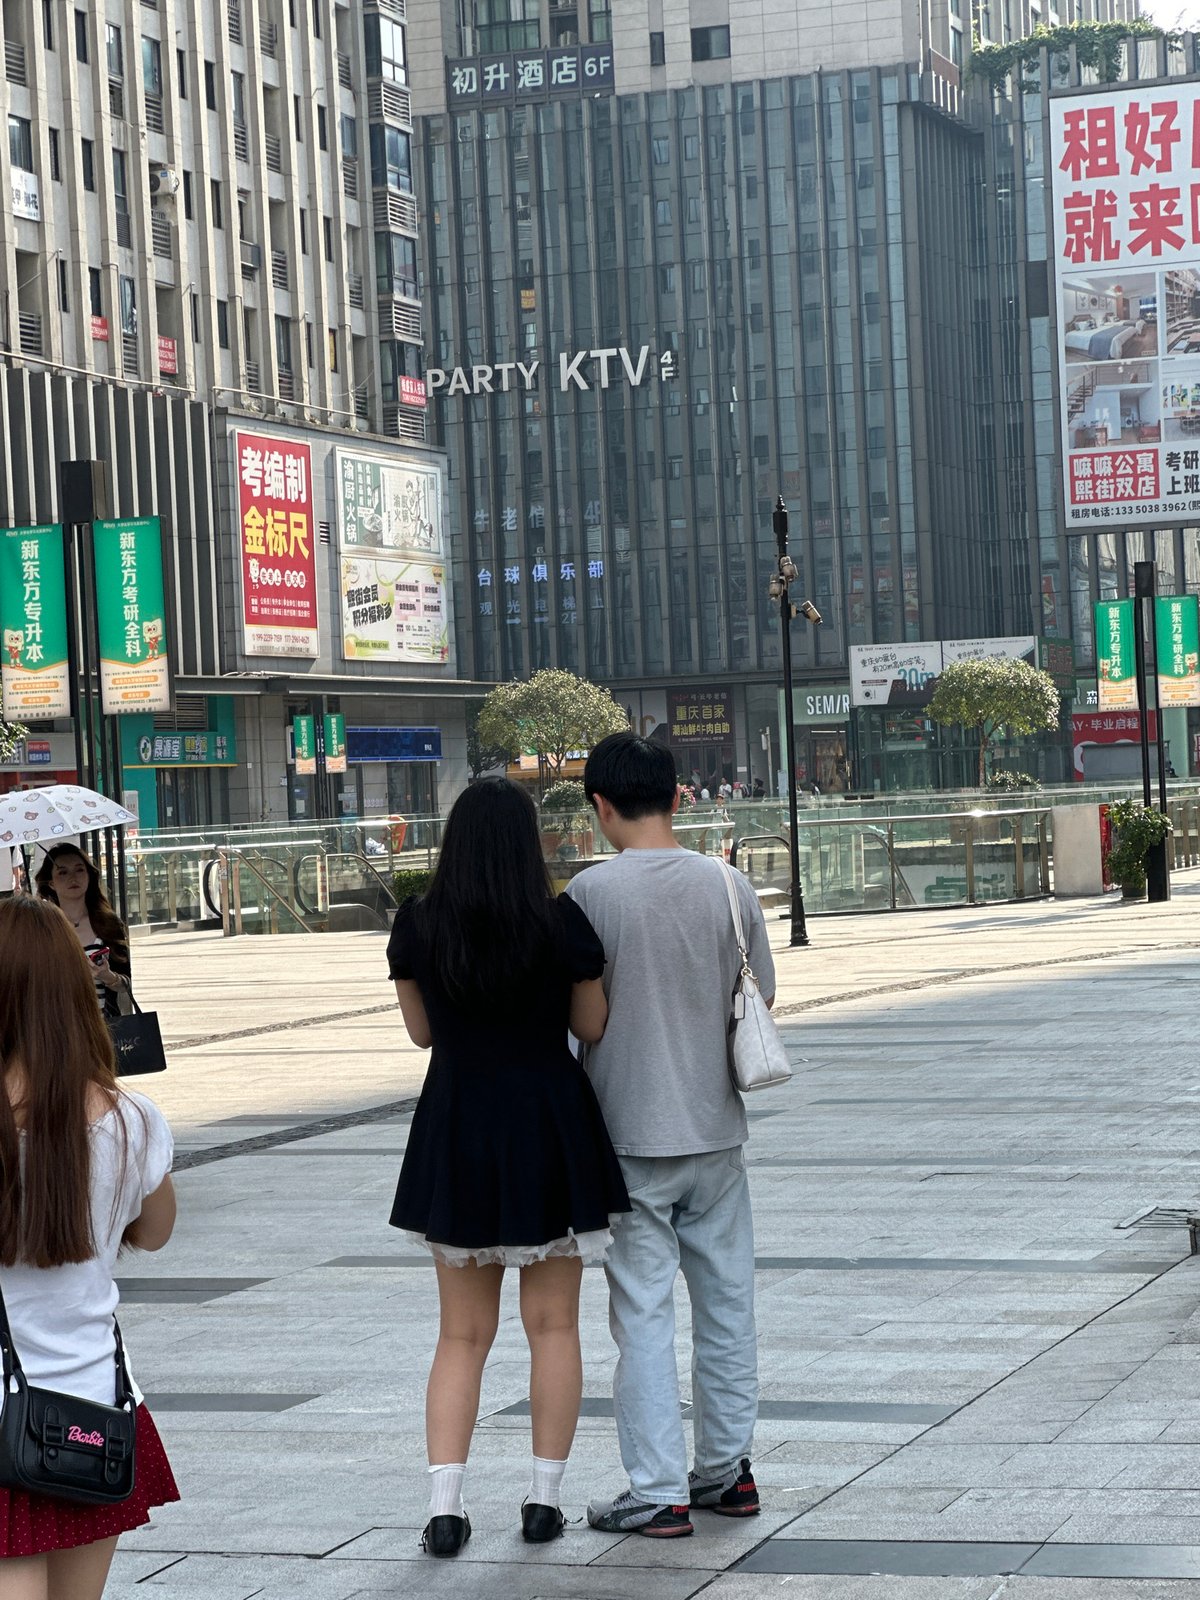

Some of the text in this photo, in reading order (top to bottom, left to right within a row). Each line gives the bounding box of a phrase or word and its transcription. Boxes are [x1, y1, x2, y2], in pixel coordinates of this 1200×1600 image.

[452, 56, 610, 94] 初升酒店 6F
[1059, 99, 1200, 181] 租好
[1063, 183, 1200, 263] 就来
[427, 361, 539, 398] PARTY
[559, 345, 649, 391] KTV
[241, 446, 307, 503] 考编制
[1073, 452, 1155, 478] 嘛嘛公寓
[1165, 451, 1200, 471] 考研
[343, 459, 357, 542] 渝厨火锅
[1074, 475, 1155, 501] 熙街双店
[1166, 474, 1200, 495] 上班
[1135, 504, 1160, 514] 5038
[1162, 502, 1187, 512] 3962
[243, 505, 310, 560] 金标尺
[477, 560, 604, 587] 台球俱乐部
[21, 540, 44, 663] 新东方专升本
[119, 532, 142, 657] 新东方考研全科
[345, 583, 379, 608] 熙街会员
[352, 602, 393, 628] 积分福利多
[1108, 606, 1122, 678] 新东方专升本
[1171, 602, 1184, 675] 新东方考研全科
[676, 704, 726, 721] 重庆首家
[67, 1425, 105, 1447] Barbie
